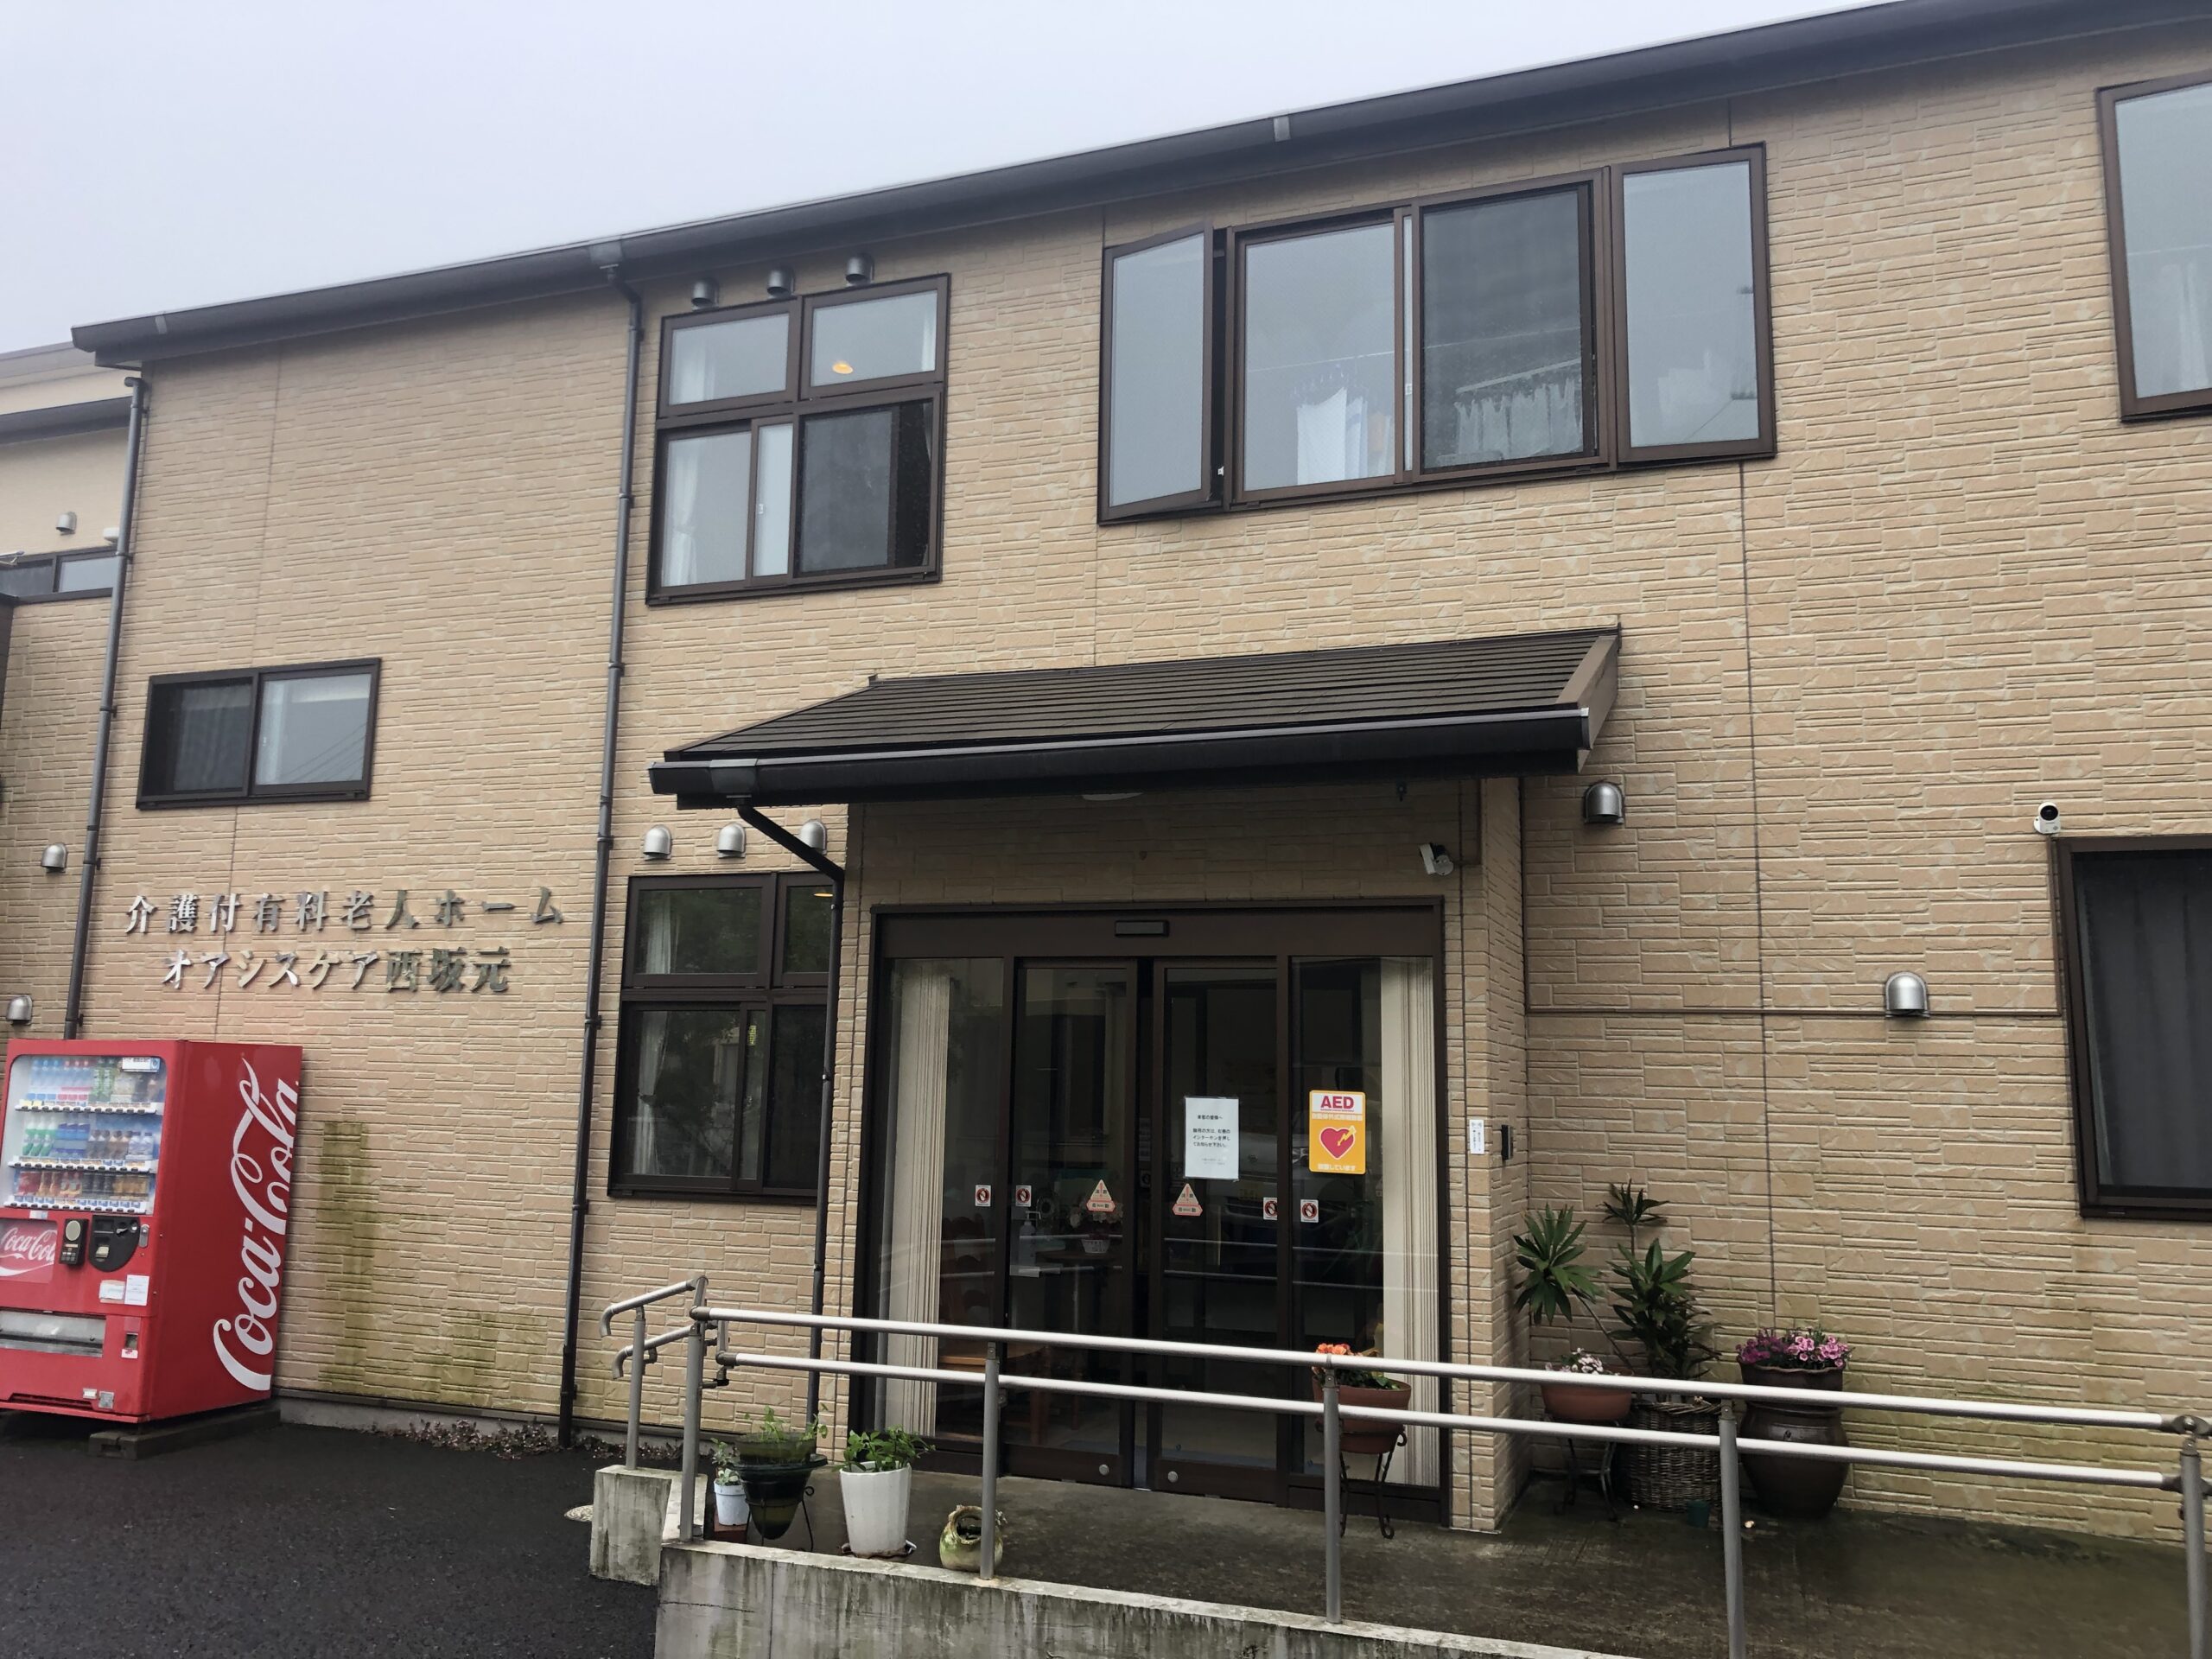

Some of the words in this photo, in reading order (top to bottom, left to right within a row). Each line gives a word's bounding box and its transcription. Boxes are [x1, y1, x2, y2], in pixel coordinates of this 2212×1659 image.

[125, 887, 563, 934] 介護付有料老人ホーム
[161, 945, 512, 993] オアシスケア西坂元
[1320, 1096, 1354, 1109] AED
